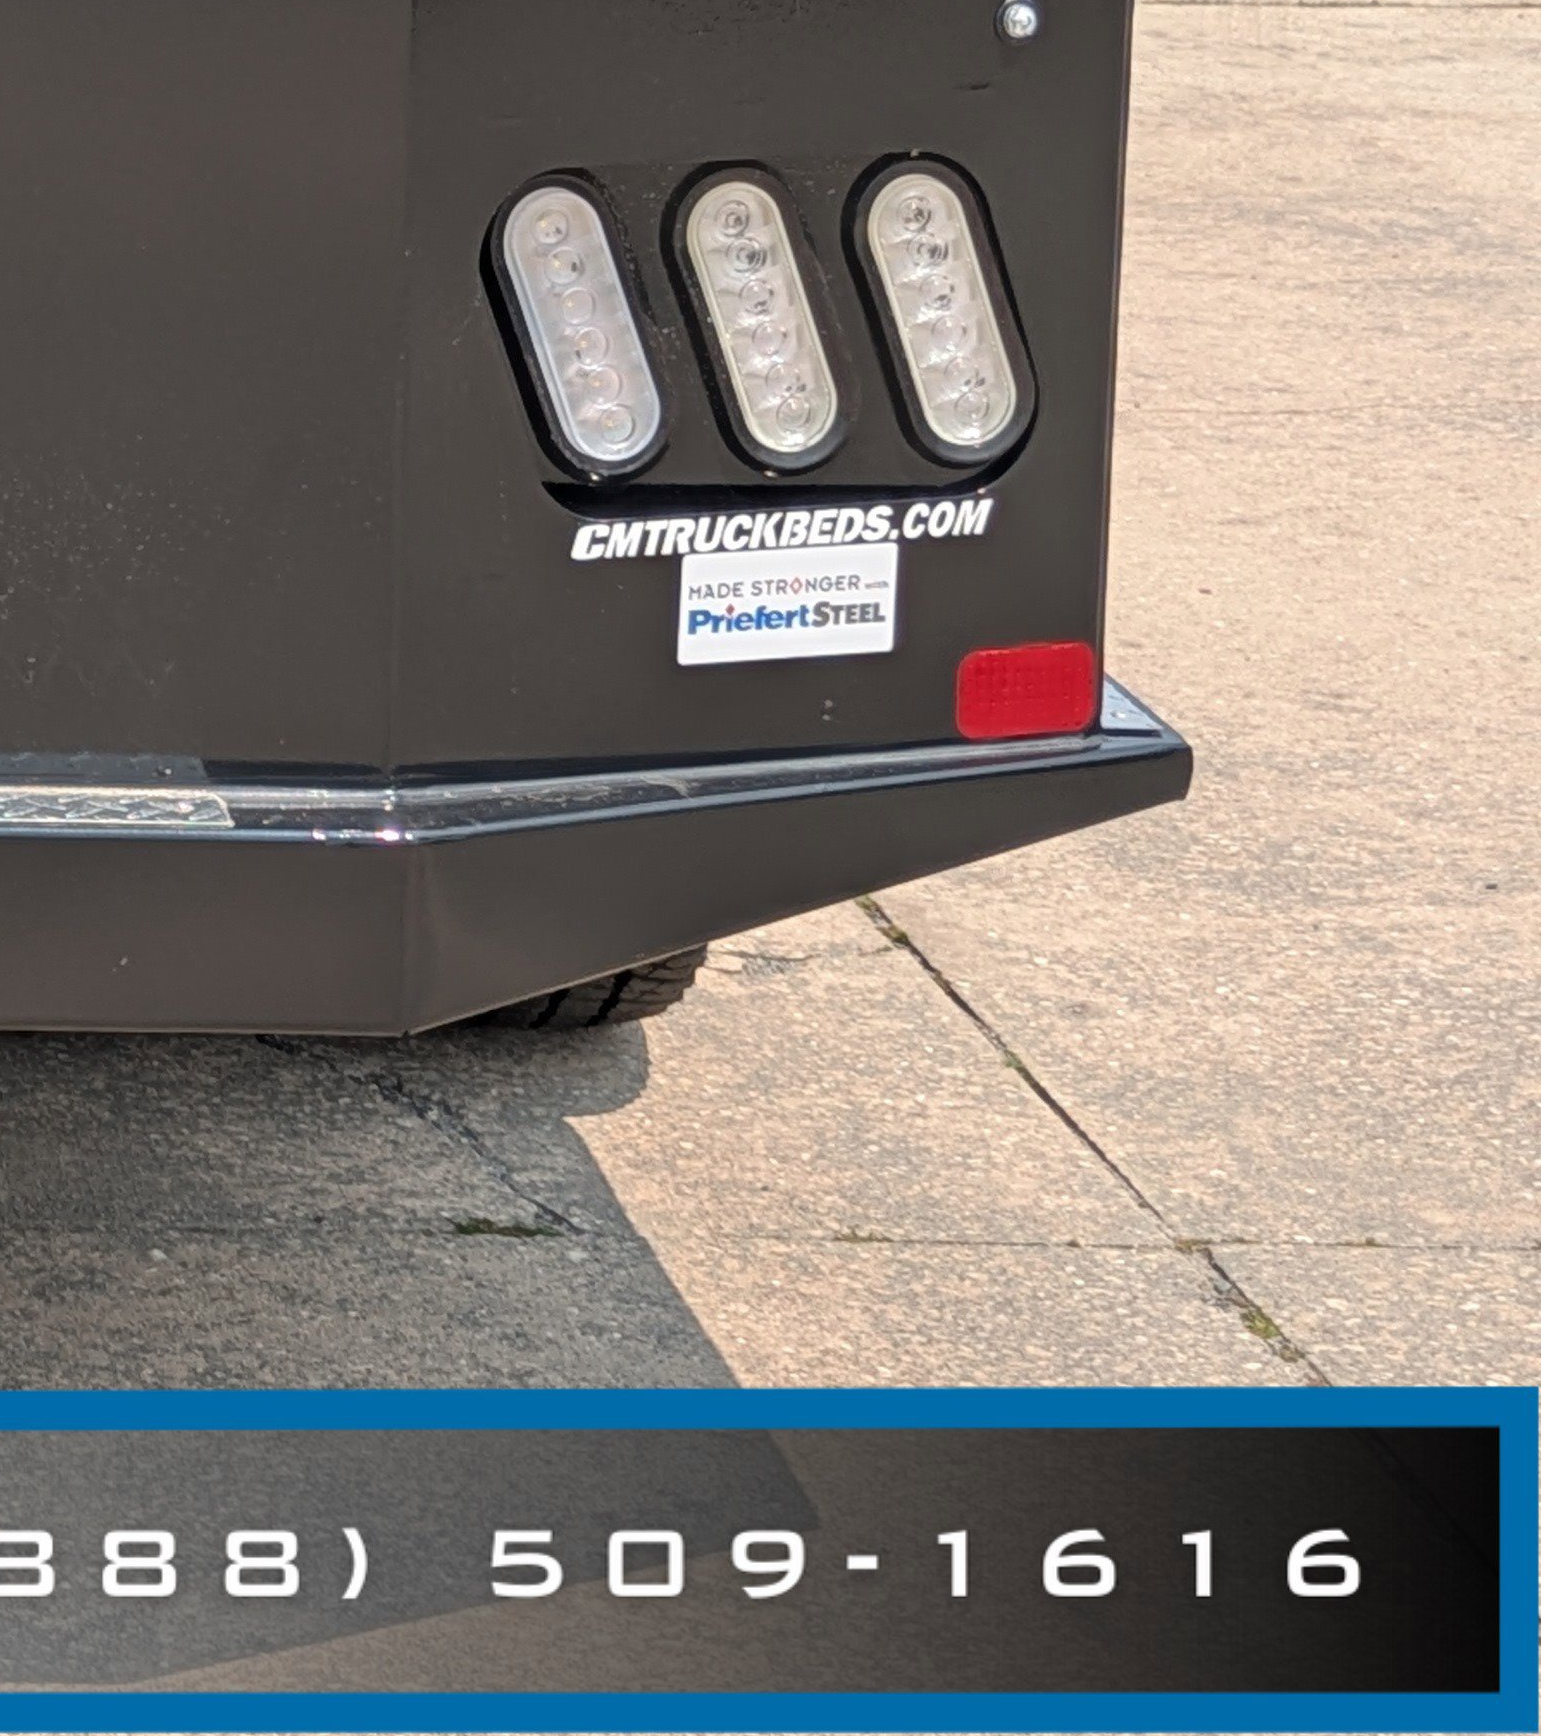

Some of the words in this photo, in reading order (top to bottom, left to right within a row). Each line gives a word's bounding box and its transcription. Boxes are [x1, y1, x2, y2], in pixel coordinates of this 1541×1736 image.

[570, 498, 994, 562] CMTRUCKBEDS.COM
[687, 580, 745, 601] MADE
[750, 574, 862, 597] STRONGER
